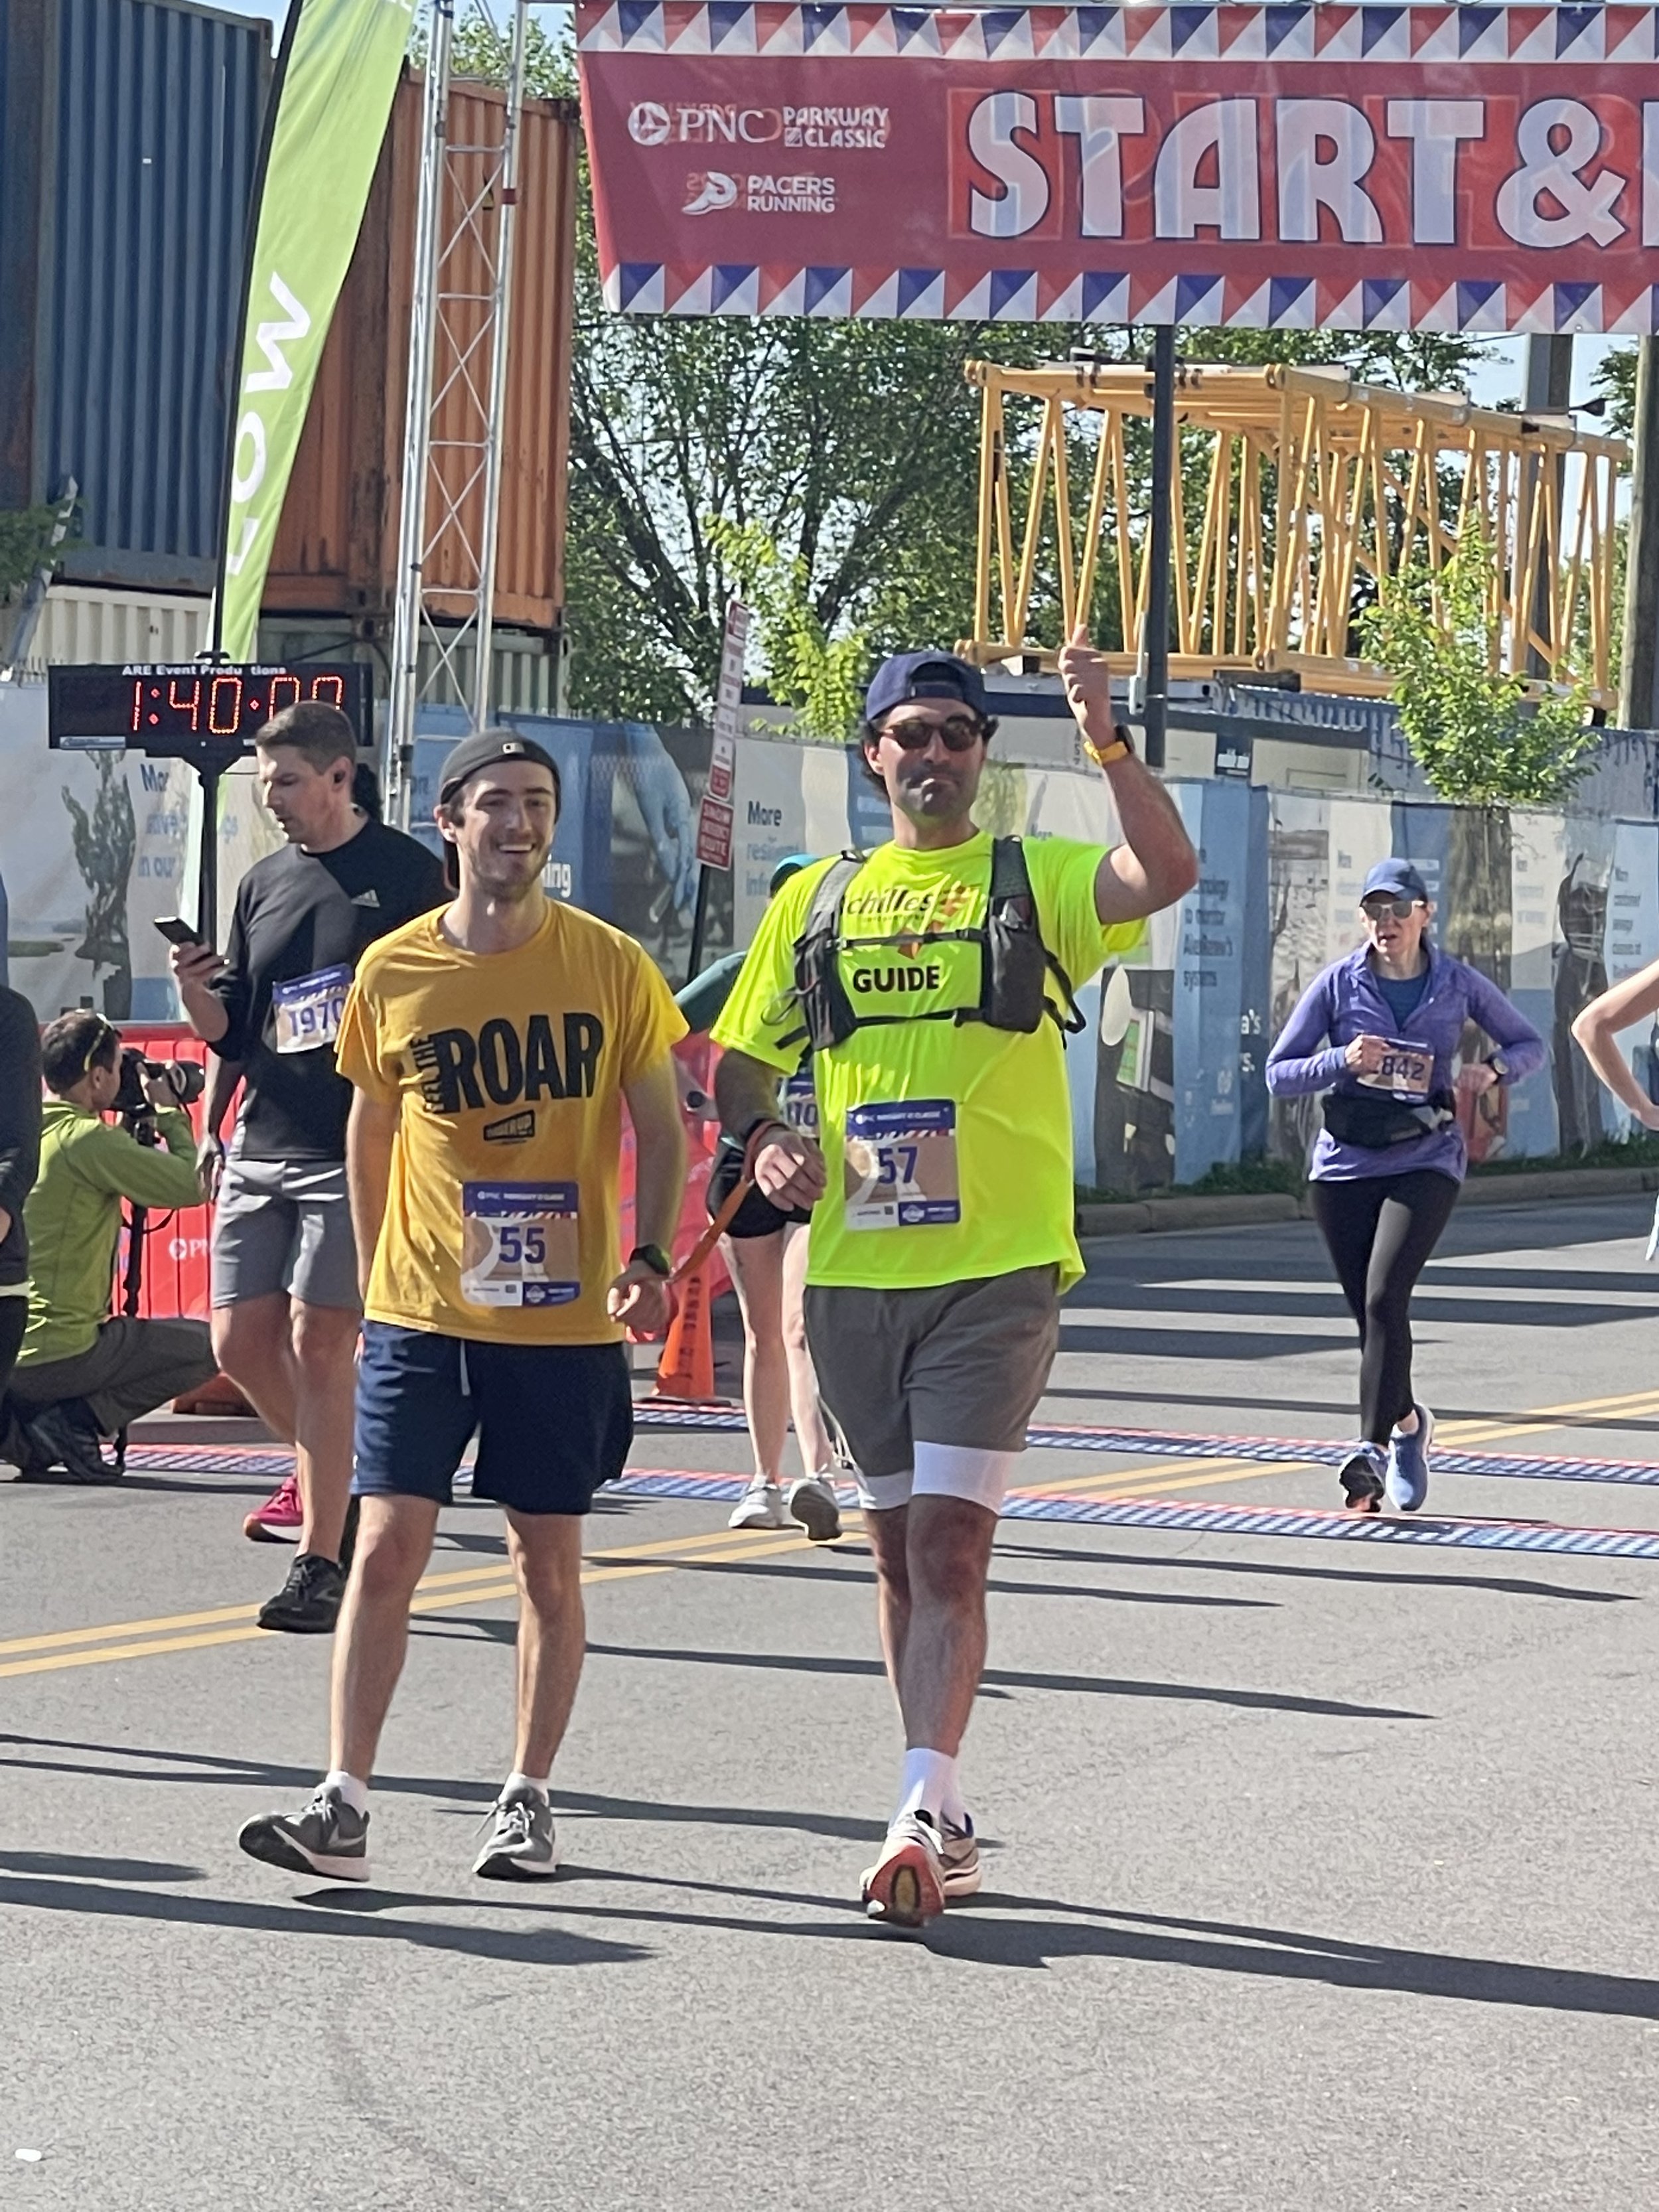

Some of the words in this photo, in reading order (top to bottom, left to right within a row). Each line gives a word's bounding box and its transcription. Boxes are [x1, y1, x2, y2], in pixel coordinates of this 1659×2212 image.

[676, 108, 764, 143] PNC
[782, 106, 890, 127] PARKWAY
[805, 128, 887, 148] CLASSIC
[747, 175, 835, 195] PACERS
[747, 196, 835, 213] RUNNING
[122, 666, 151, 676] ARE
[156, 666, 196, 676] Event
[201, 666, 286, 676] Produtions
[747, 800, 782, 826] More
[541, 853, 571, 898] ing
[853, 965, 940, 993] GUIDE
[1240, 1008, 1262, 1035] a's
[429, 1012, 604, 1114] ROAR
[1372, 1055, 1425, 1081] 842
[877, 1145, 918, 1184] 57
[498, 1226, 546, 1264] 55
